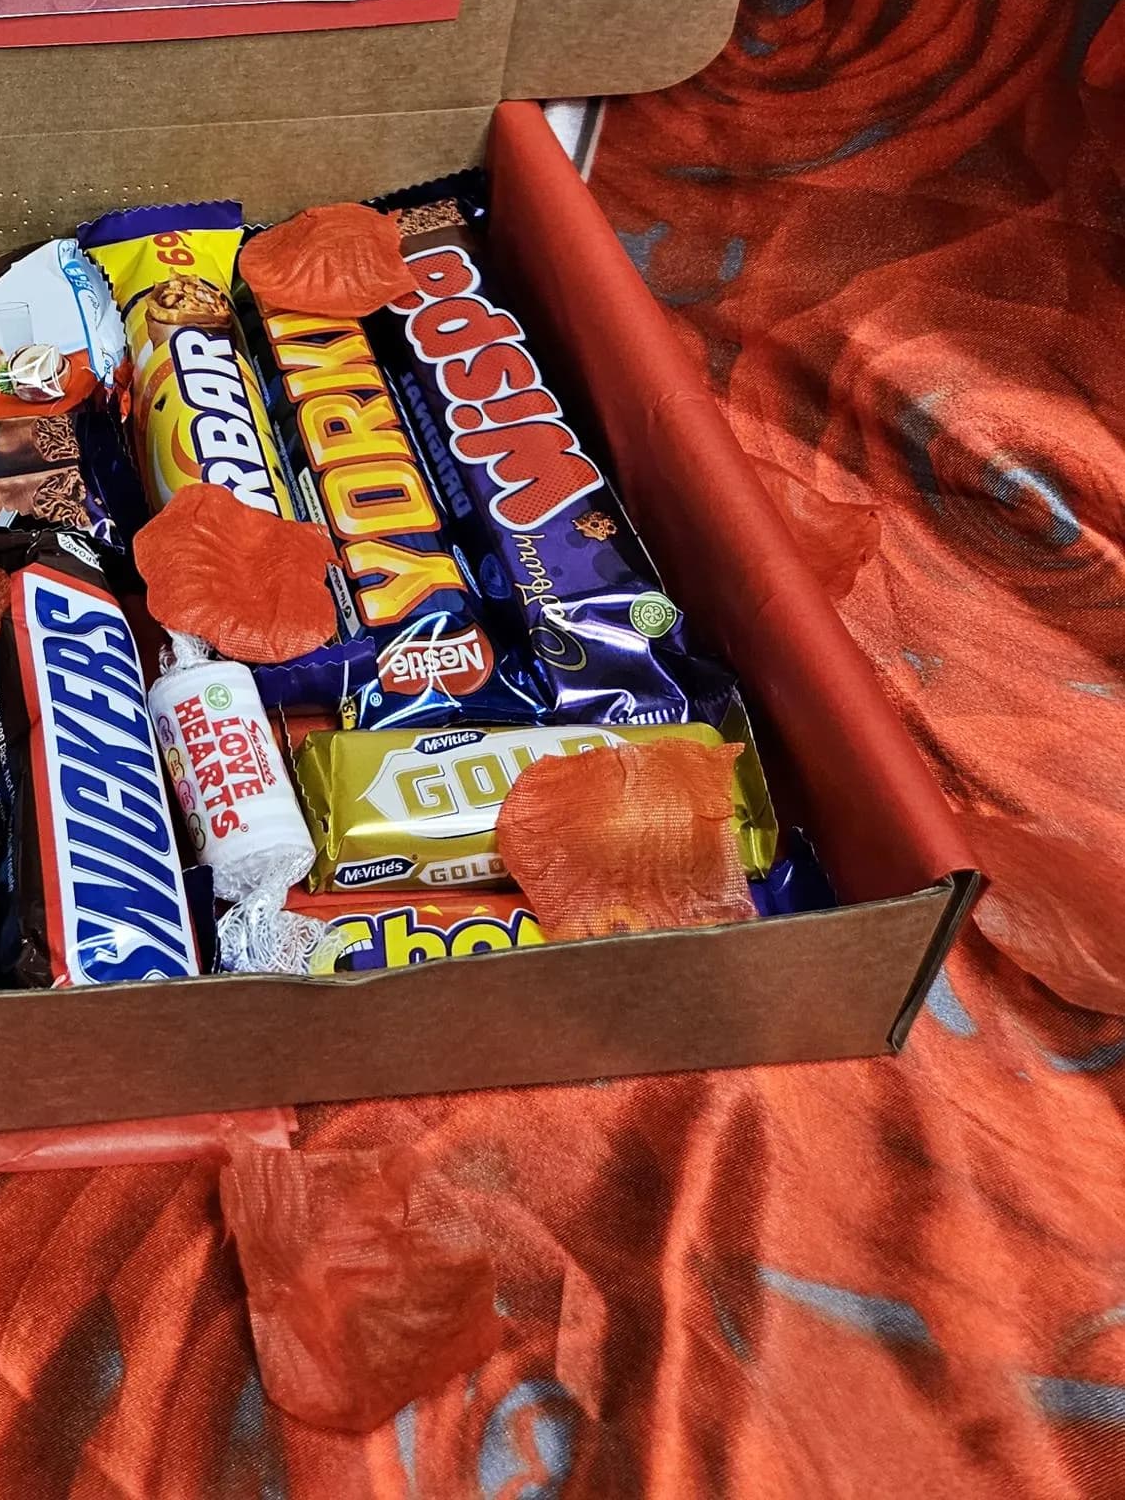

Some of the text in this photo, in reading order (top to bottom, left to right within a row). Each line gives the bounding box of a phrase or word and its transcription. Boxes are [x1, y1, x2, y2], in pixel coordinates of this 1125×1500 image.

[173, 329, 280, 515] RBAR
[264, 310, 465, 626] YORKI
[387, 245, 605, 531] Wispa
[35, 585, 190, 984] SNICKERS
[173, 694, 241, 839] HEARTS
[211, 716, 265, 800] LOVE
[343, 860, 404, 884] McVitie's
